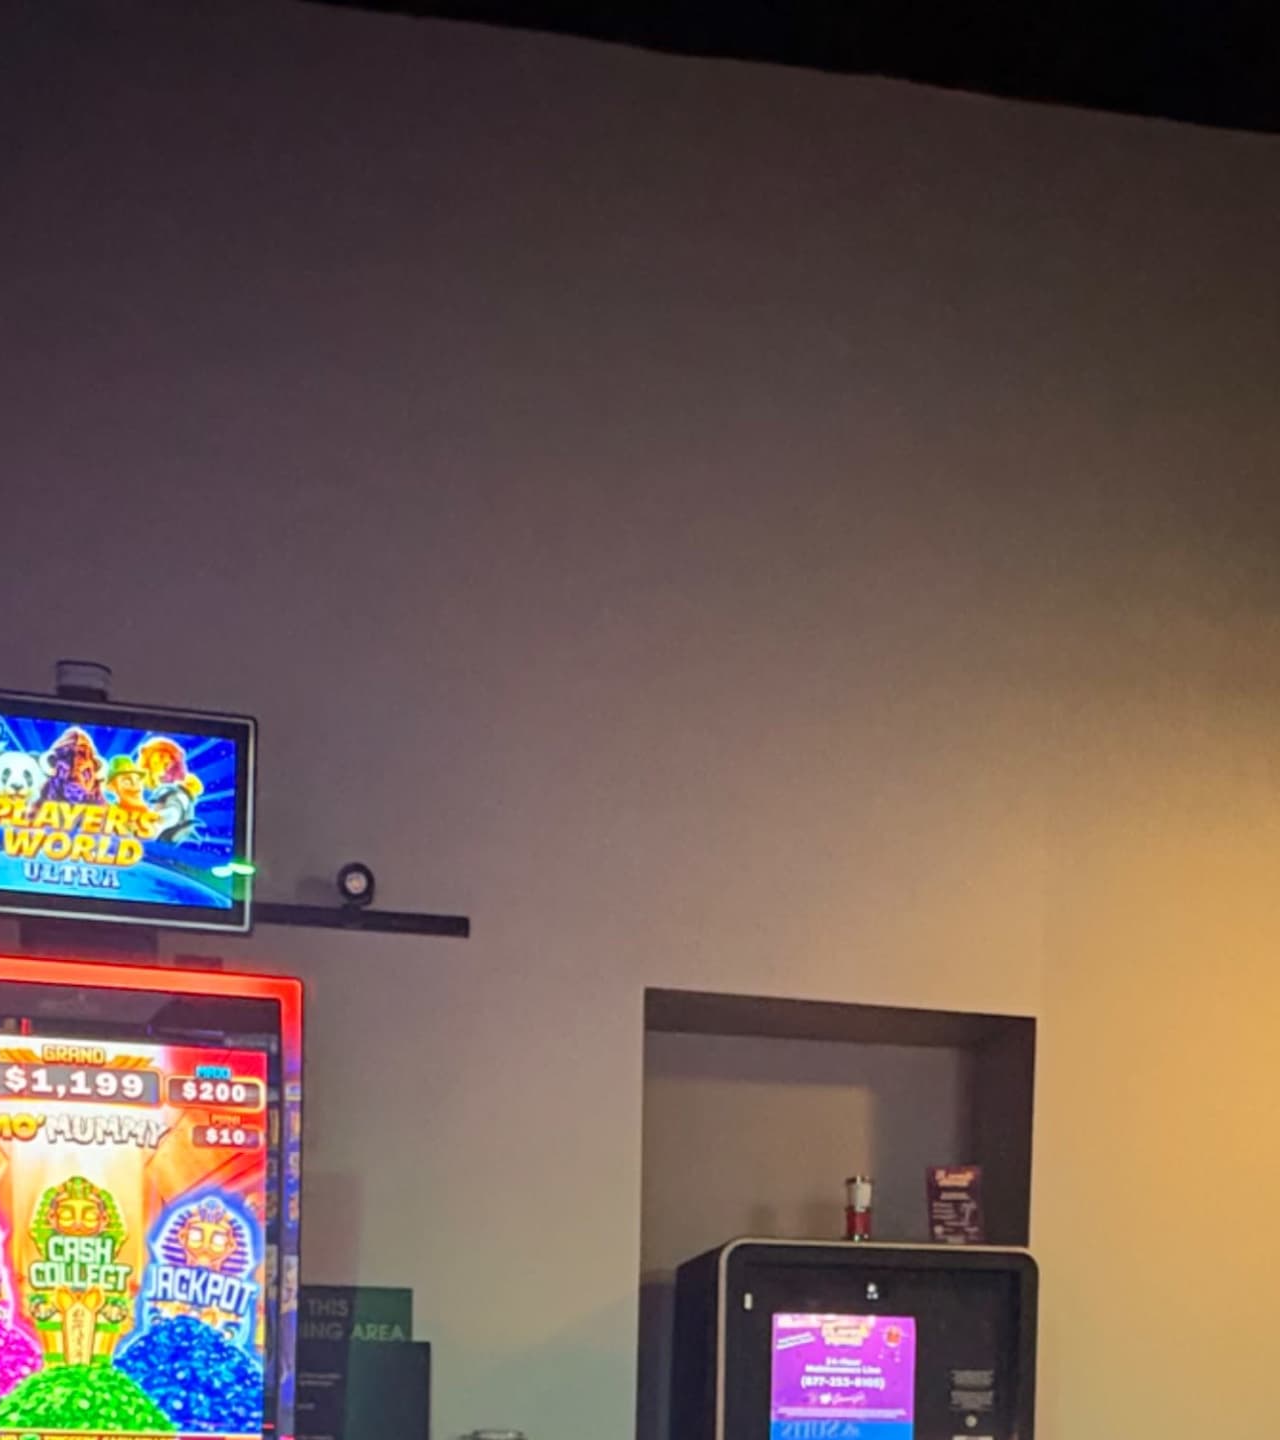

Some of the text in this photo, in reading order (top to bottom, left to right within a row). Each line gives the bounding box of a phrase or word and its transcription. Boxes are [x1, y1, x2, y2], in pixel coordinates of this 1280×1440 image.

[4, 827, 144, 867] WORLD
[23, 862, 121, 888] ULTRA
[42, 1044, 106, 1064] GRAND
[5, 1065, 144, 1098] $1,199
[182, 1081, 247, 1102] $200
[206, 1128, 246, 1145] $10
[48, 1236, 113, 1263] CASH
[31, 1261, 130, 1291] COLLECT
[147, 1263, 259, 1315] JACKPOT
[350, 1322, 406, 1341] AREA
